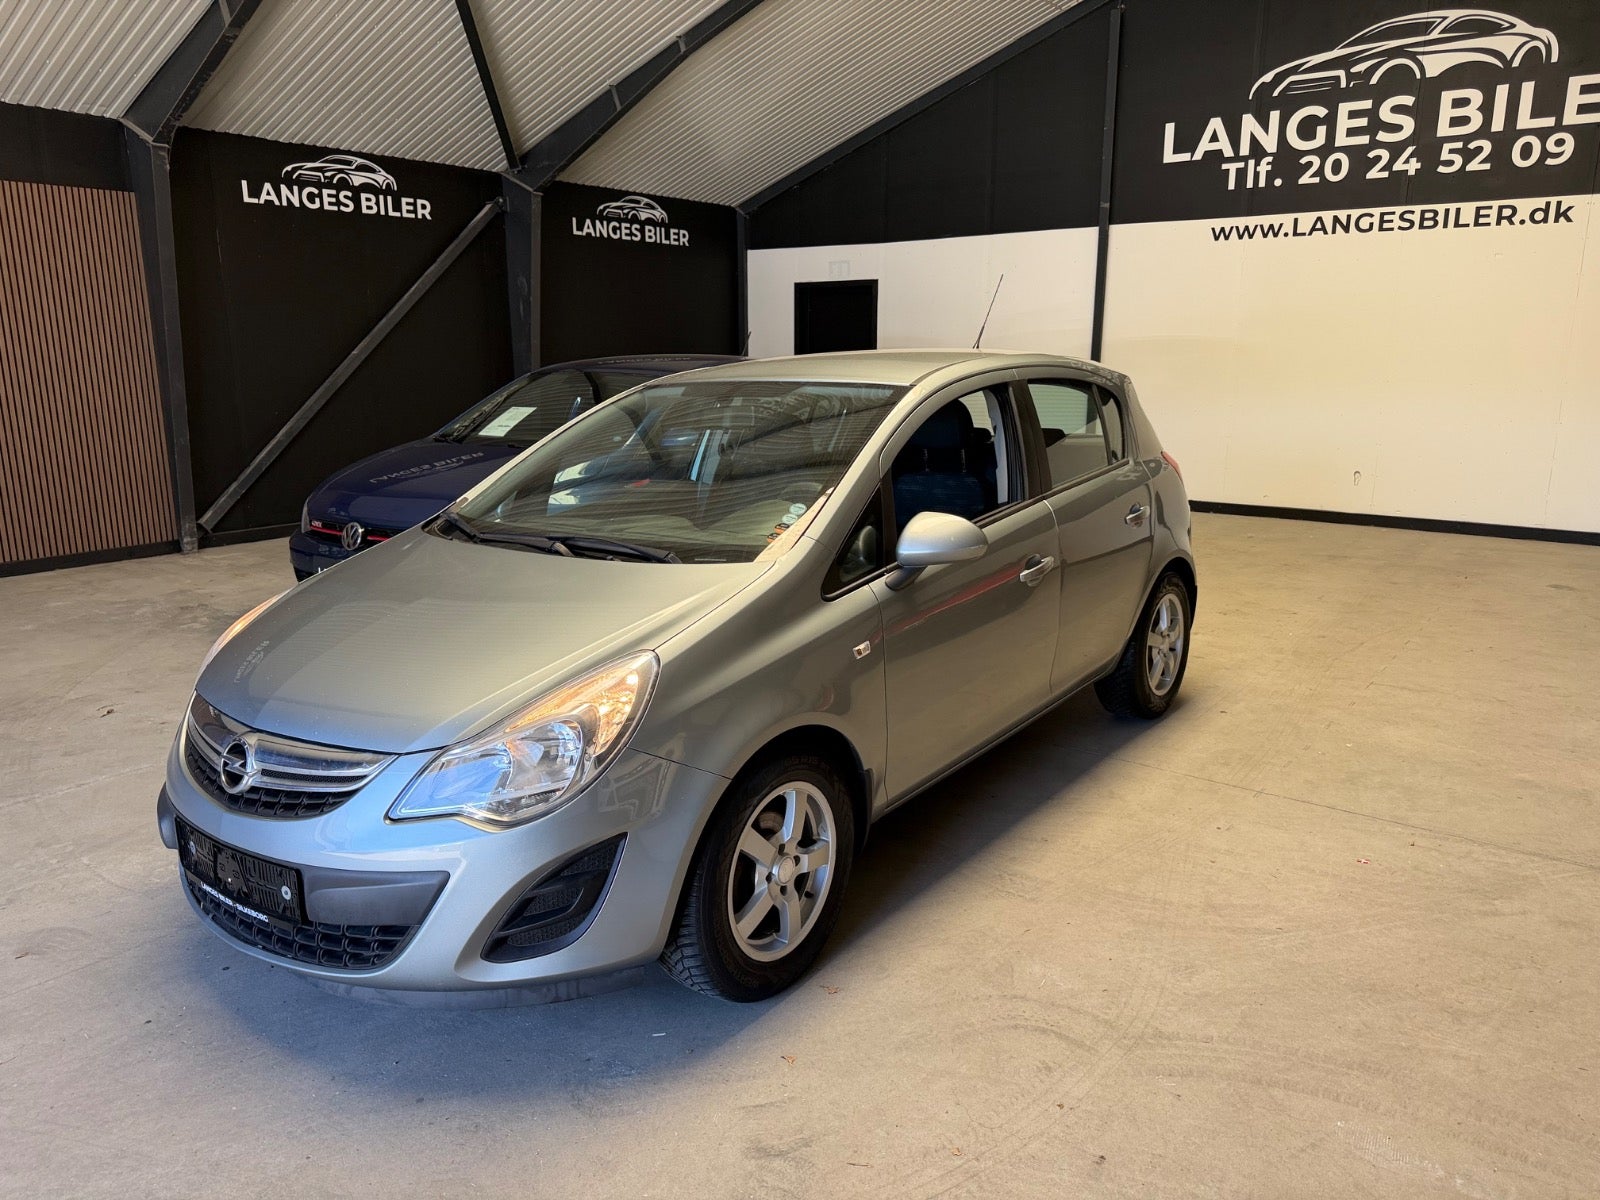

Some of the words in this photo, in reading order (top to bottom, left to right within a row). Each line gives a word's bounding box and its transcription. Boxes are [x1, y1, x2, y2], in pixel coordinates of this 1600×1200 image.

[1163, 95, 1416, 163] LANGES
[1222, 156, 1283, 190] Tlf.
[1298, 153, 1350, 184] 20
[1366, 146, 1421, 179] 24
[1437, 140, 1492, 173] 52
[1512, 132, 1575, 167] 09
[241, 180, 354, 212] LANGES
[360, 193, 432, 220] BILER
[572, 217, 641, 242] LANGES
[645, 225, 689, 246] BILER
[1212, 201, 1574, 241] www.LANGESBILER.dk
